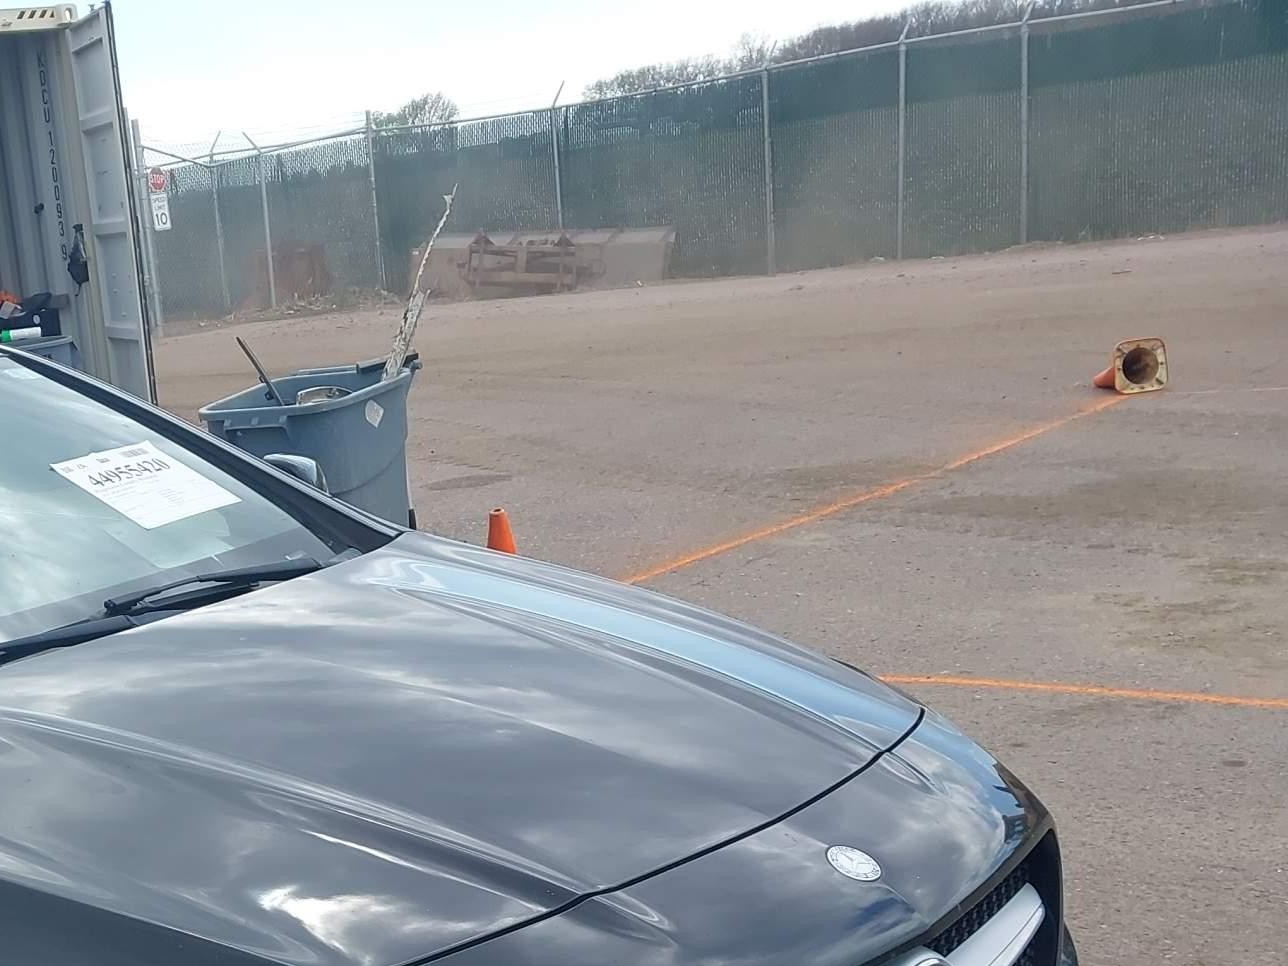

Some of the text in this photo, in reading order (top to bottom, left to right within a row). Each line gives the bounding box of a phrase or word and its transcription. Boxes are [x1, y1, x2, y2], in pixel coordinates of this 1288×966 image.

[48, 130, 65, 237] 120093
[155, 212, 168, 226] 10
[88, 457, 172, 488] 44955420
